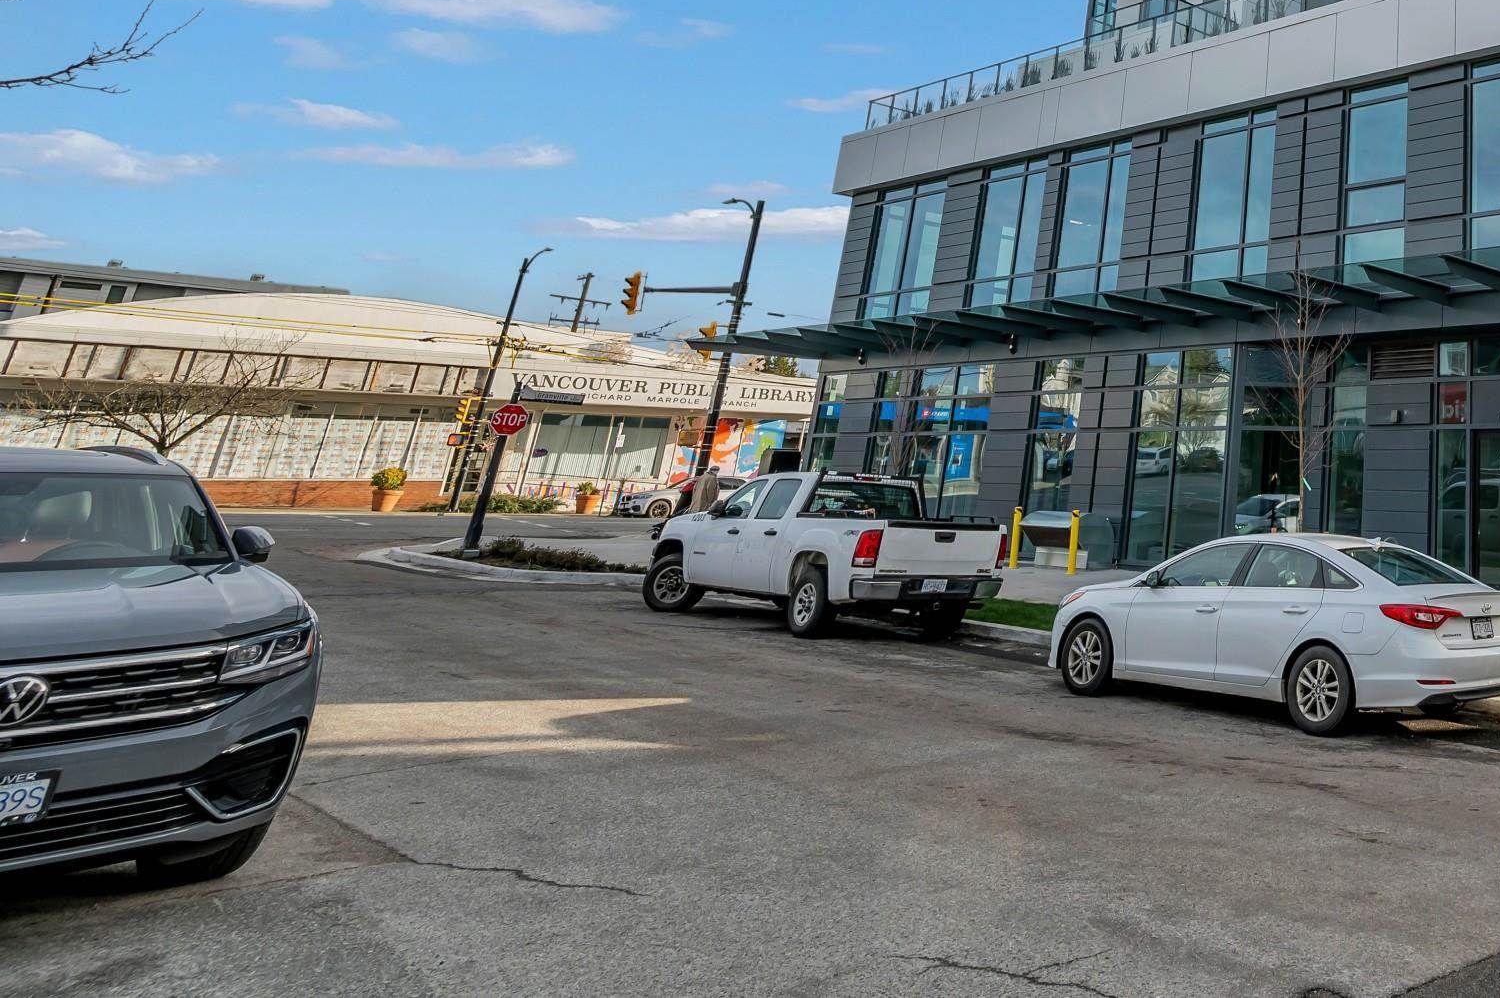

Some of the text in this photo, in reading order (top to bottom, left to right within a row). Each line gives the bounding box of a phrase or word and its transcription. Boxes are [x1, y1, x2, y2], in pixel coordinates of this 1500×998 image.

[512, 372, 815, 403] VANCOUVER PUBL LIBRARY
[537, 392, 568, 401] Granville
[646, 396, 700, 404] MARPOLE
[493, 413, 527, 426] STOP
